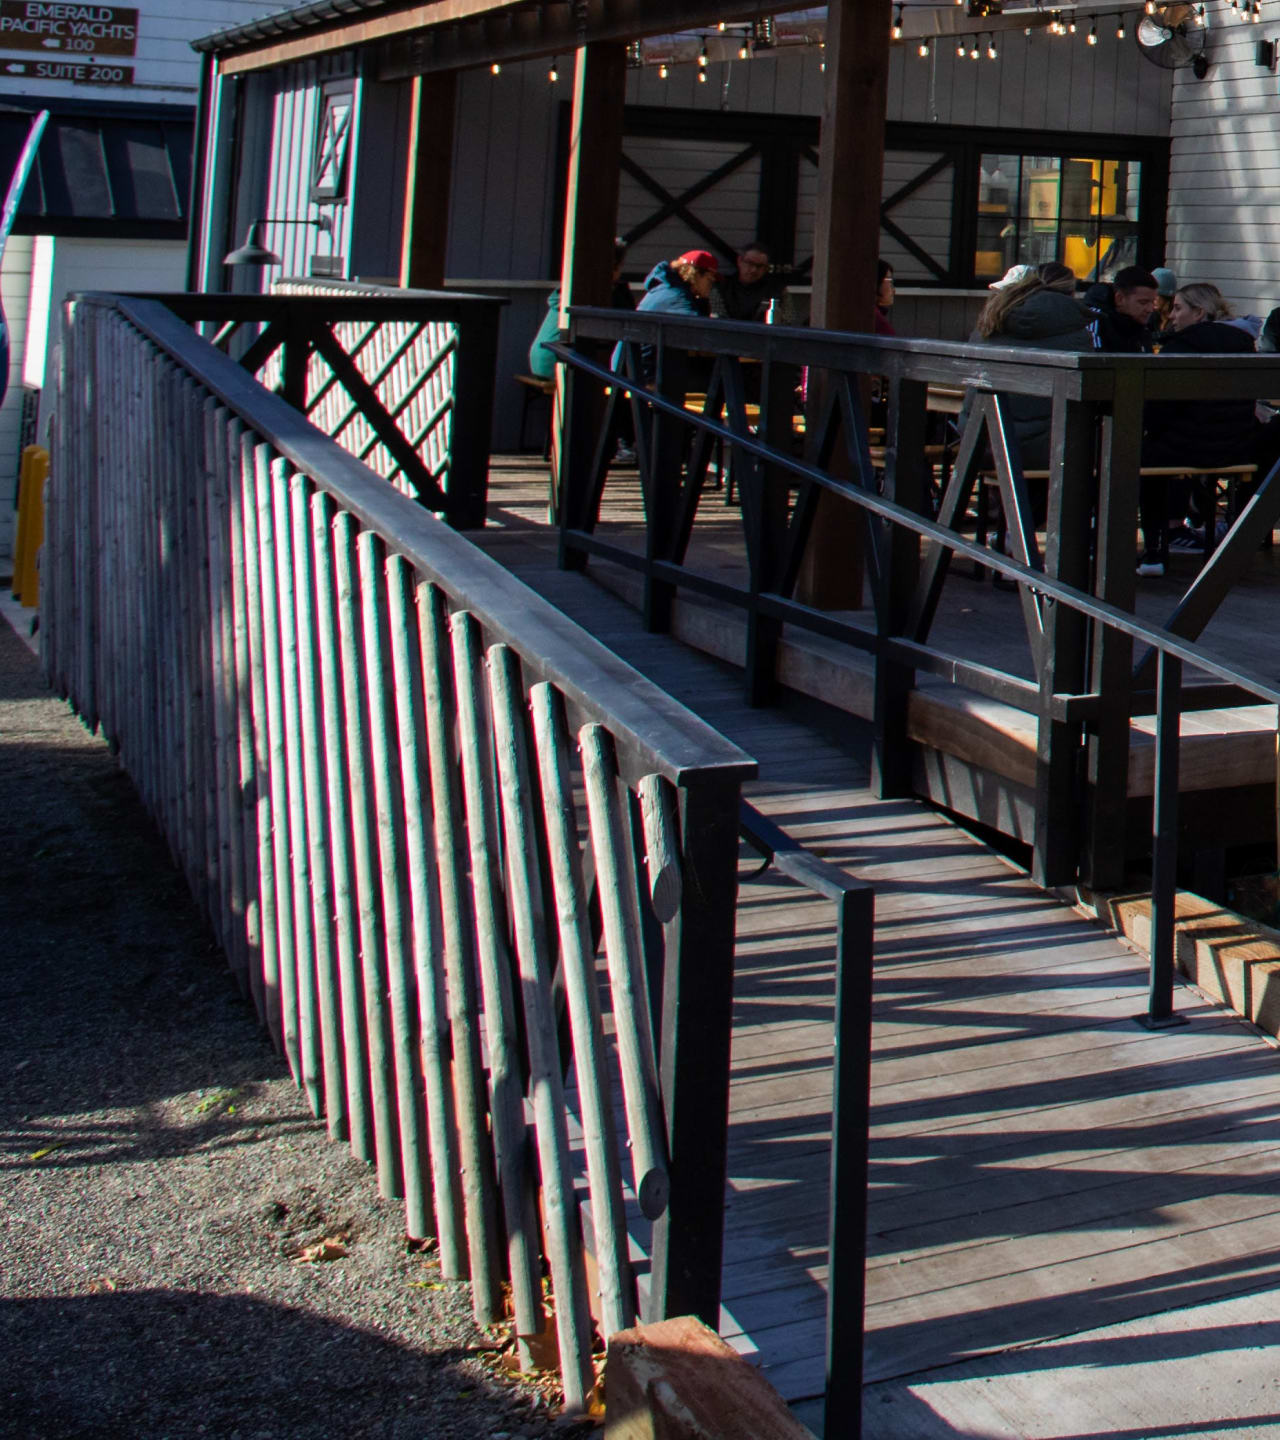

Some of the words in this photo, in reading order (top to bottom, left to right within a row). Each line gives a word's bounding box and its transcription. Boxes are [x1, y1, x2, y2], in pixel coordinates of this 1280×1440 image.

[26, 3, 113, 22] EMERALD
[0, 17, 66, 35] PACIFIC
[70, 21, 136, 40] YACHTS
[65, 38, 96, 52] 100
[36, 63, 86, 80] SUITE
[90, 67, 124, 82] 200
